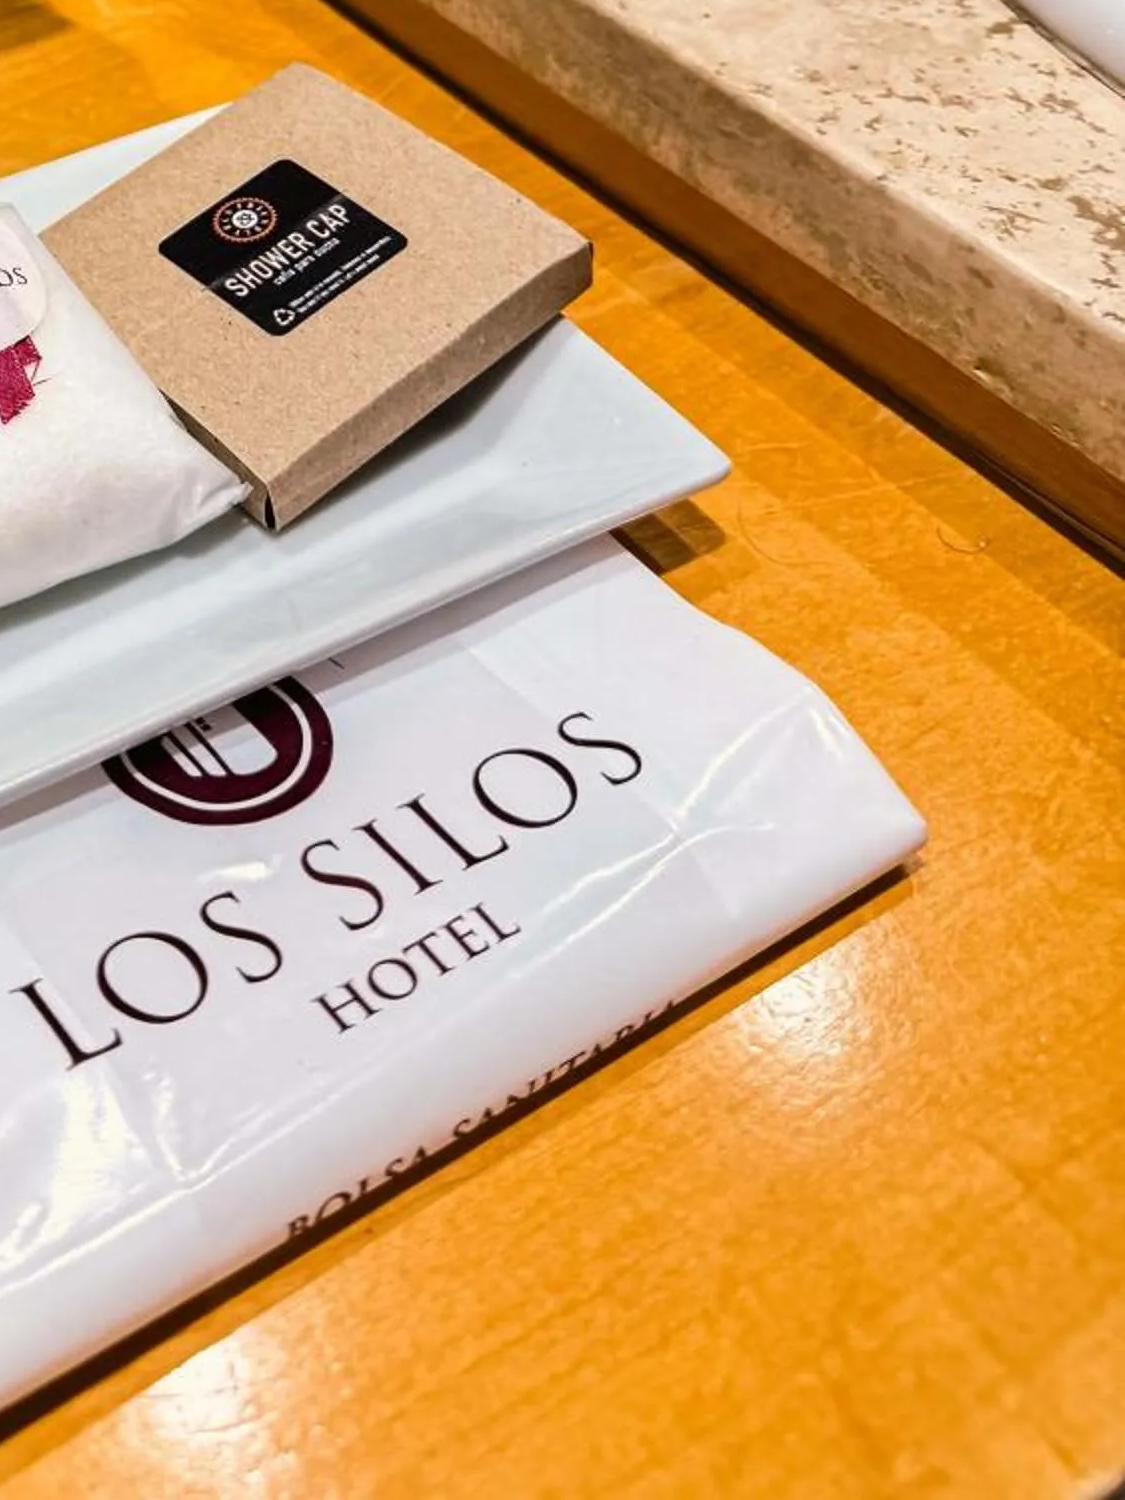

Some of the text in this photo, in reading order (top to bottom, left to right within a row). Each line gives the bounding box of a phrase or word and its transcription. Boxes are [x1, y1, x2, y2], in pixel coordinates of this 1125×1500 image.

[225, 231, 316, 298] SHOWER
[306, 203, 351, 240] CAP
[8, 710, 643, 1072] LOS SILOS
[310, 901, 523, 1035] HOTEL
